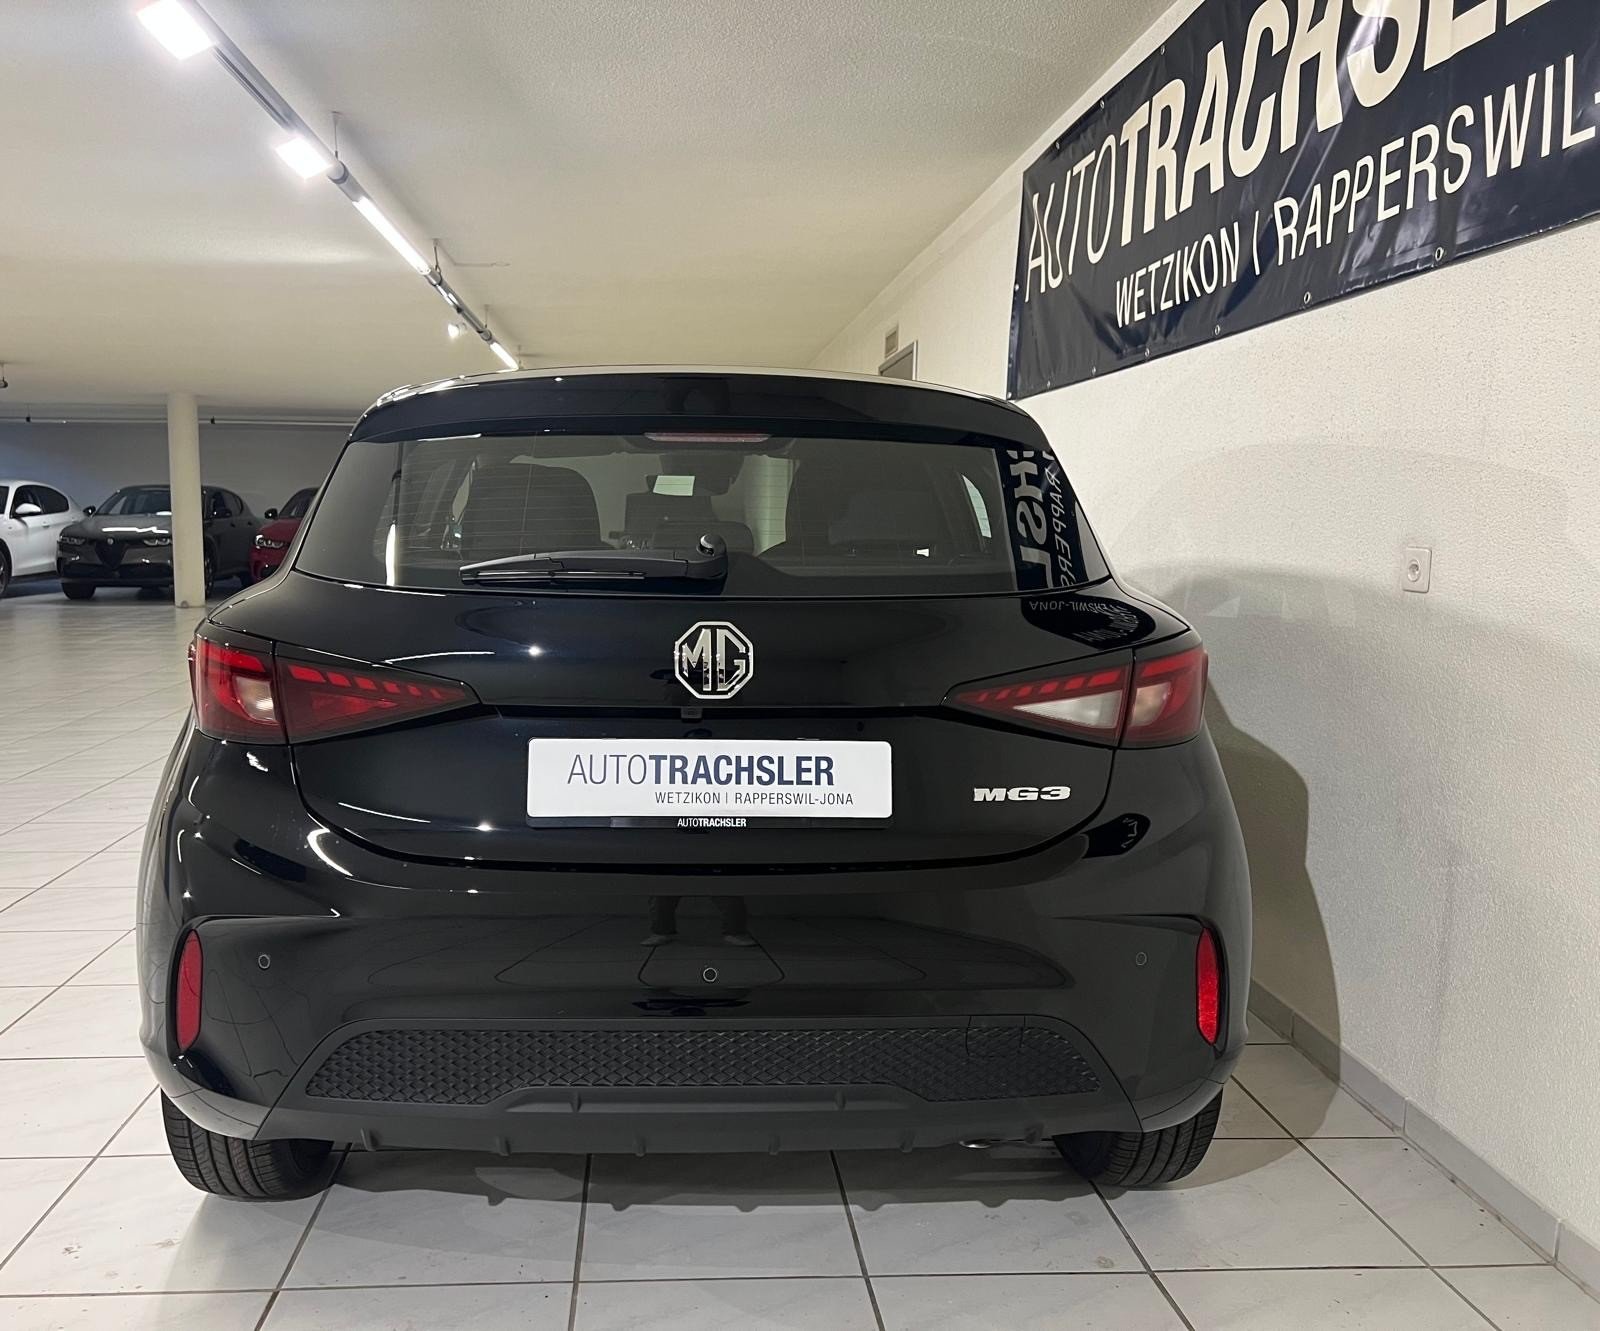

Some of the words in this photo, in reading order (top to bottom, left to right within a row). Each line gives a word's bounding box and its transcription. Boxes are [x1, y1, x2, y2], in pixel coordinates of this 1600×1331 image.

[1025, 0, 1550, 303] AUTOTRACHS
[1115, 221, 1240, 329] WETZIKON
[1273, 54, 1600, 266] RAPPERSWIL
[681, 628, 746, 692] MG
[567, 754, 834, 786] AUTOTRACHSLER
[655, 792, 721, 804] WETZIKON
[734, 792, 854, 805] RAPPERSWIL-JONA
[973, 786, 1071, 802] MG3
[677, 817, 747, 828] AUTOTRACHSLER
